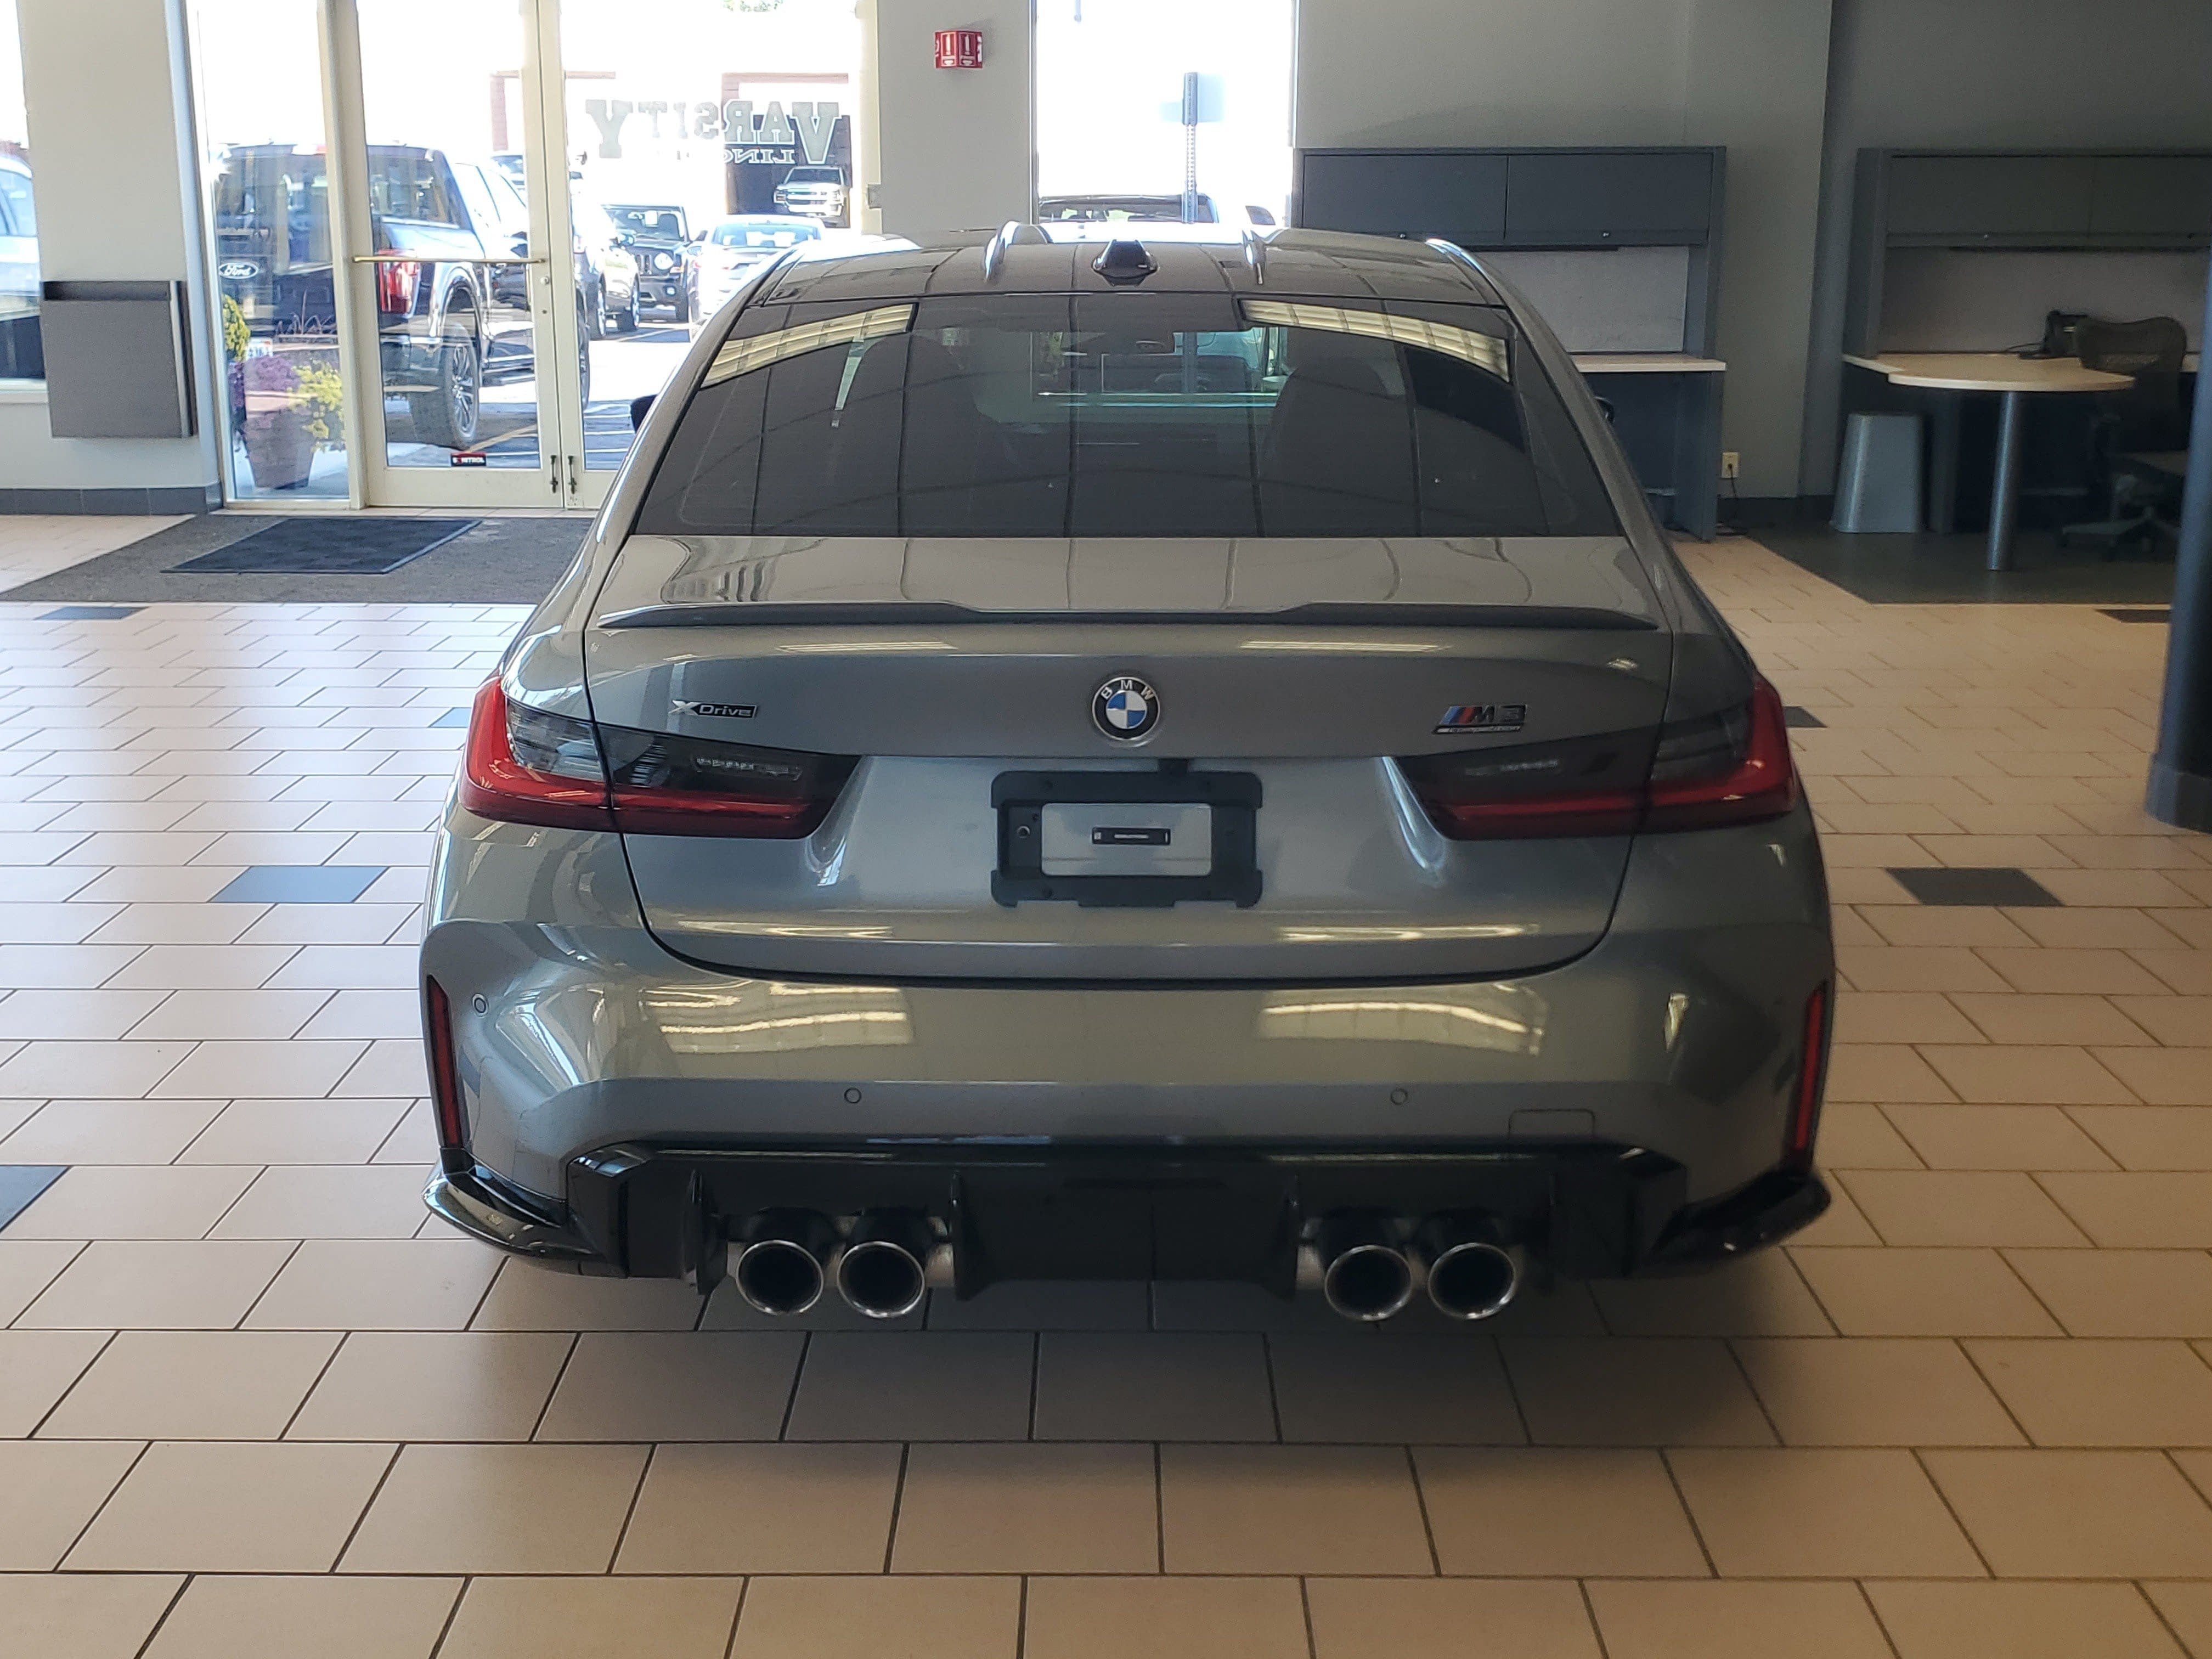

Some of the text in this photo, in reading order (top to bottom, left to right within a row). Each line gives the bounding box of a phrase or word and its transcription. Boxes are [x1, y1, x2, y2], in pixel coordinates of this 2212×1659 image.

[222, 264, 252, 276] Ford
[1100, 679, 1155, 700] BMW
[1469, 704, 1527, 724] M3
